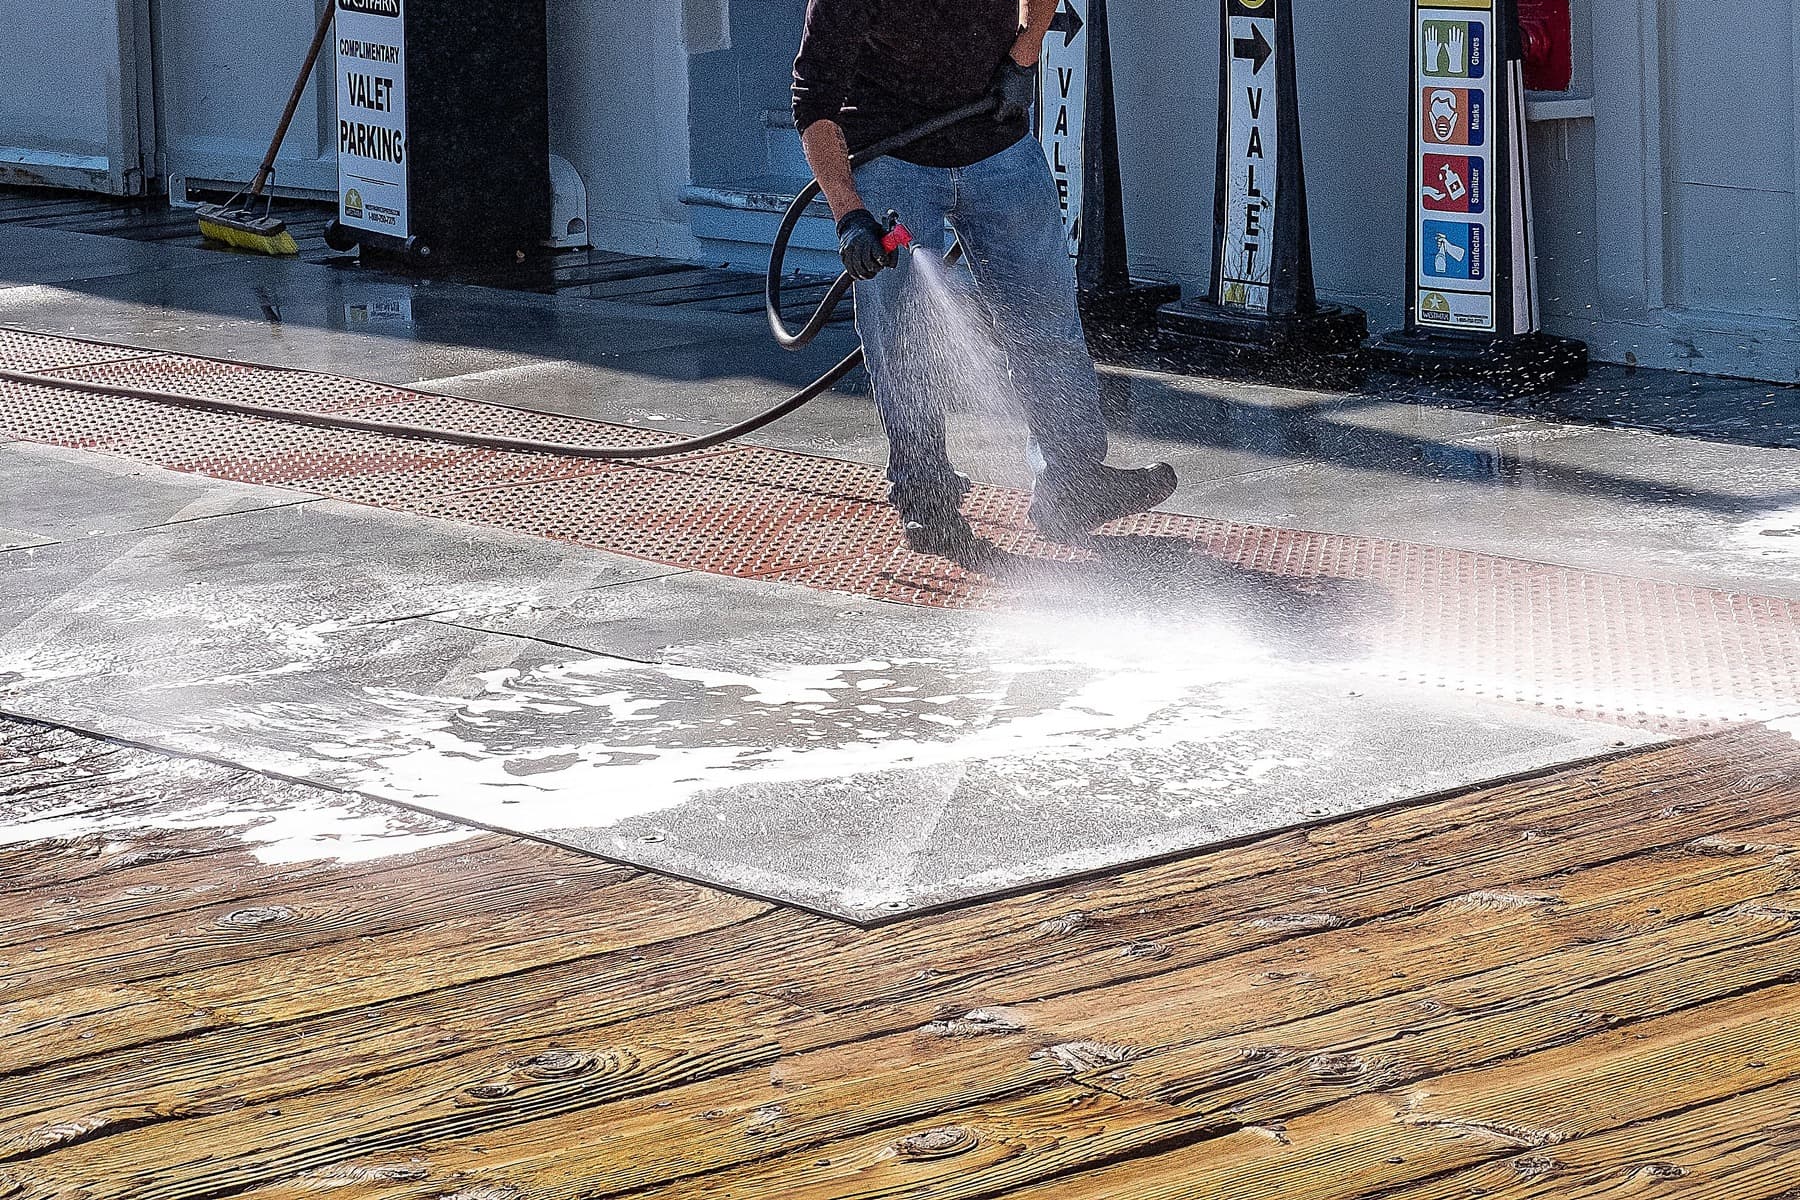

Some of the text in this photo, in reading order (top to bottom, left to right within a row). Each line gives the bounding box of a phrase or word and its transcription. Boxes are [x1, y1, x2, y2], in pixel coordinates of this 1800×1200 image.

[339, 38, 400, 65] COMPLIMENTARY
[1471, 37, 1480, 66] Gloves
[347, 71, 393, 113] VALET
[1471, 103, 1480, 130] Masks
[340, 119, 403, 165] PARKING
[1054, 67, 1073, 225] VALE
[1244, 86, 1264, 275] VALET
[1471, 168, 1479, 204] Sanitizer
[1471, 227, 1480, 276] Disinfectant
